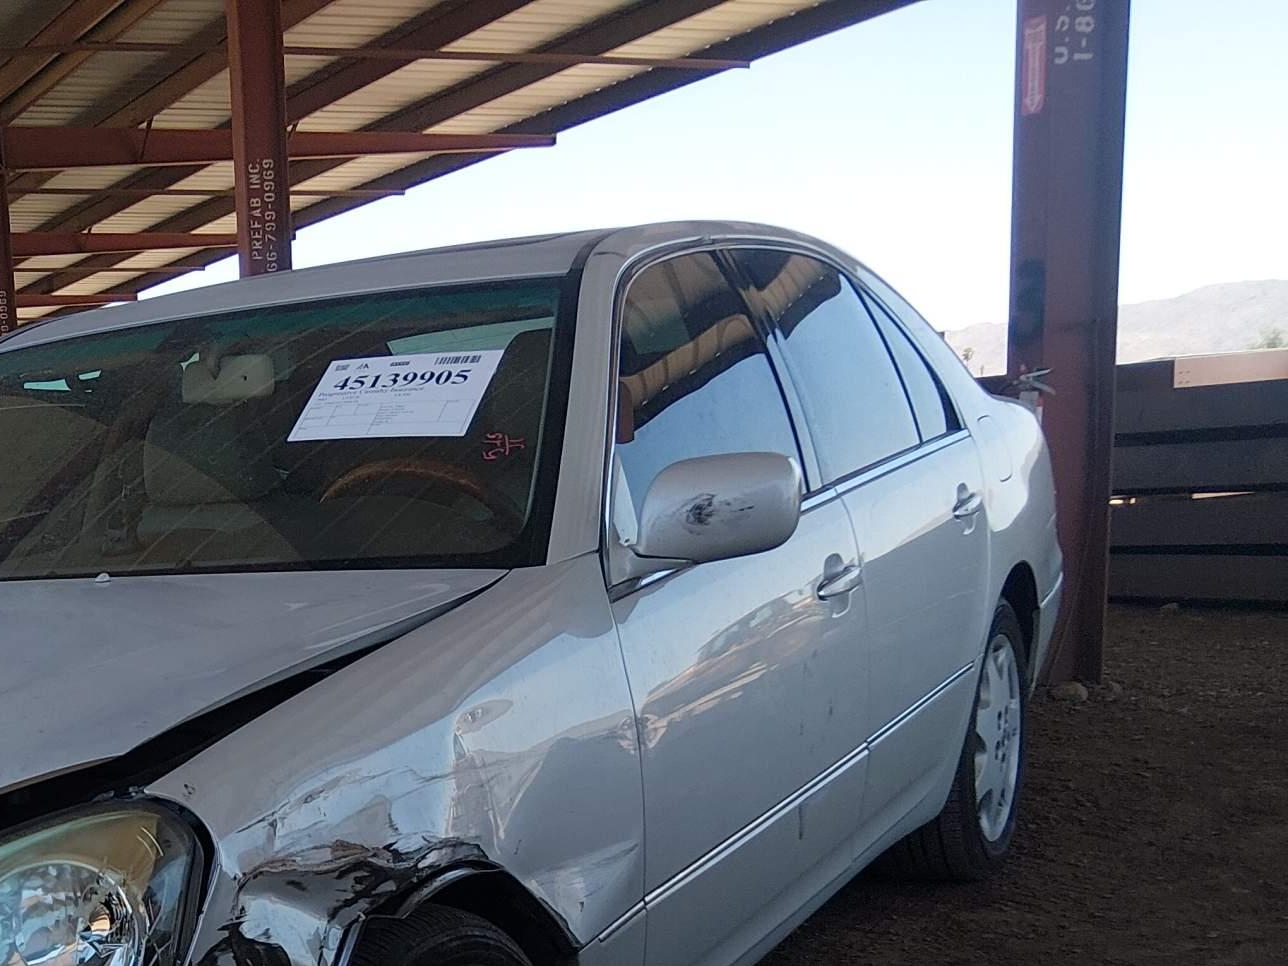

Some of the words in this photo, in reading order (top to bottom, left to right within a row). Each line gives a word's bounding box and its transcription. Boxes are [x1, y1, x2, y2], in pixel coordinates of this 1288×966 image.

[248, 158, 261, 189] INC.
[250, 197, 263, 260] PREFAB
[262, 158, 278, 272] 66-799-0969
[333, 368, 472, 391] 45139905
